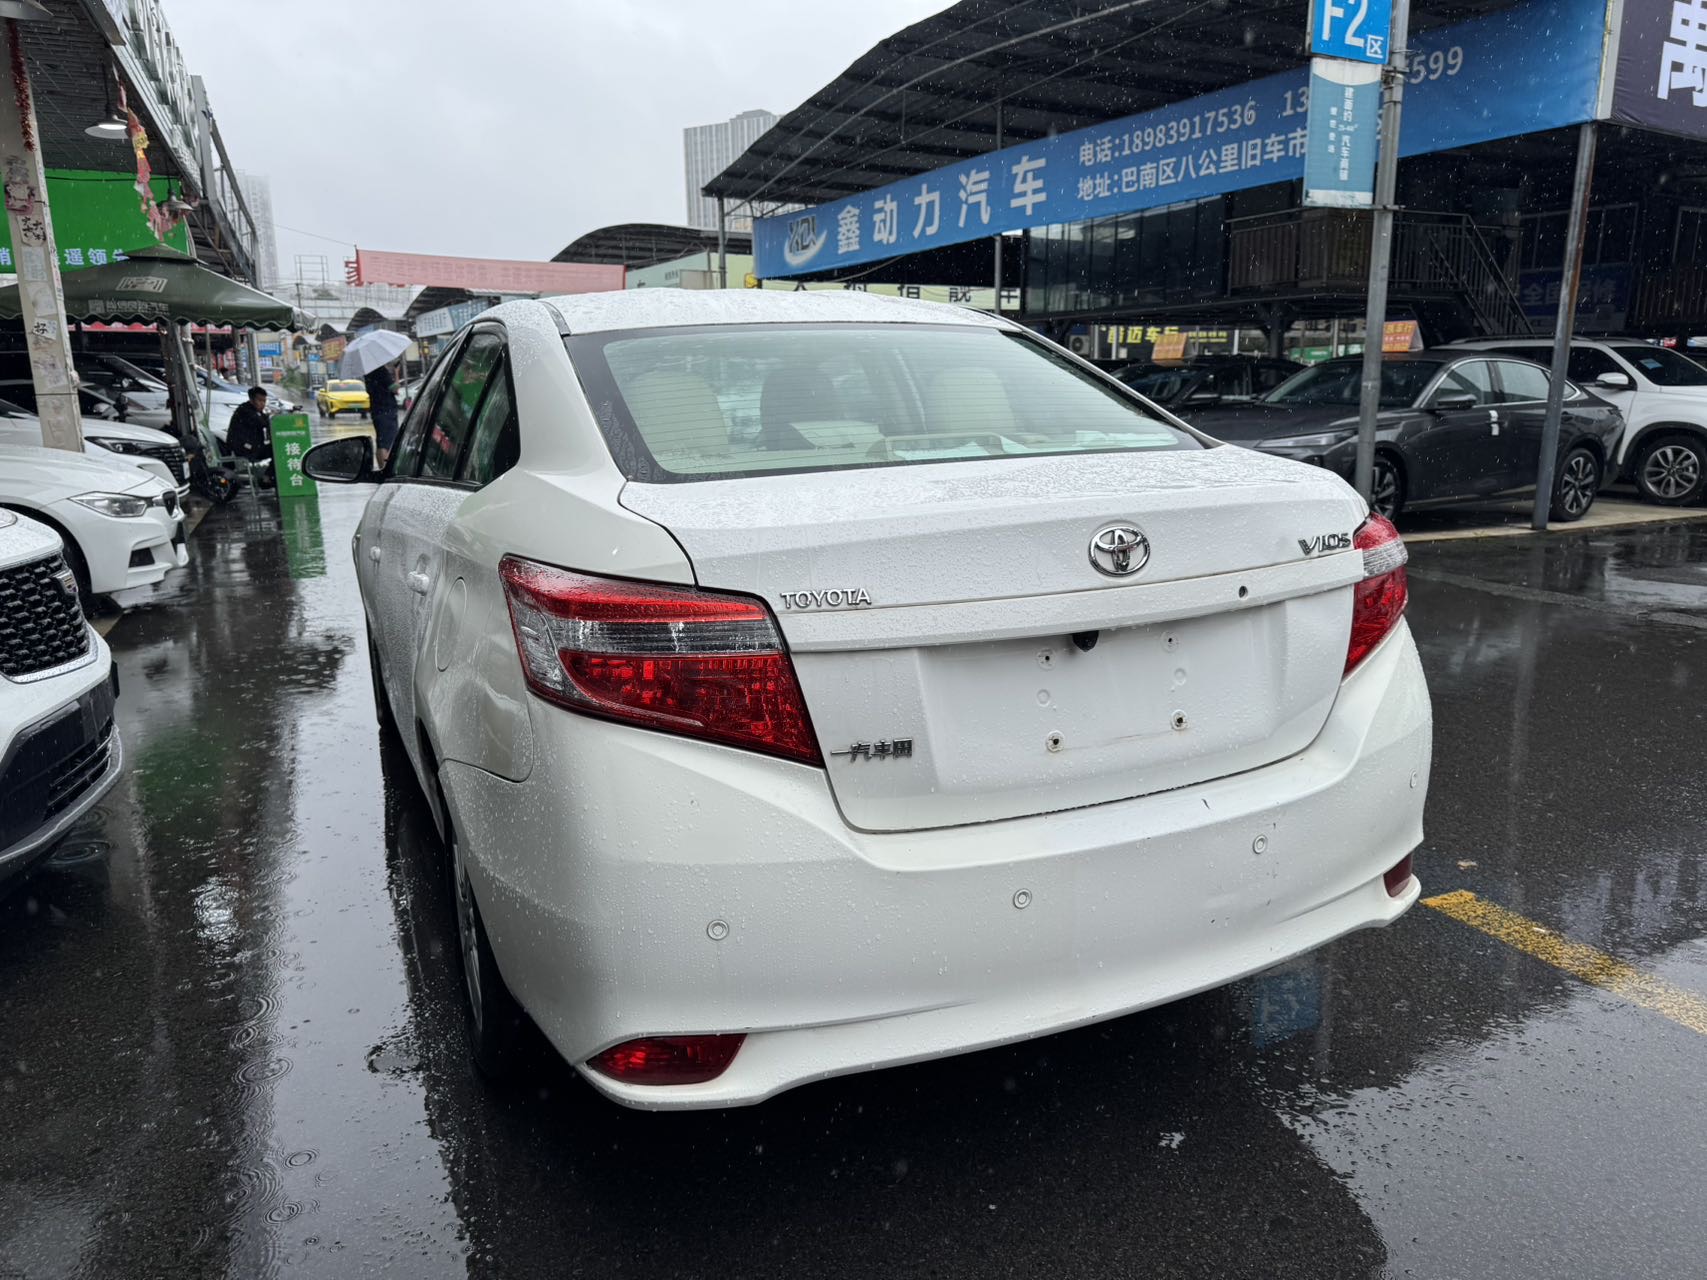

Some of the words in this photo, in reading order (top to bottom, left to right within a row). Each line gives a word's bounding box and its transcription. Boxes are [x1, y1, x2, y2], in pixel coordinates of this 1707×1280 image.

[837, 155, 1048, 255] 鑫动力汽车
[285, 442, 303, 486] 接待台
[1297, 532, 1352, 556] VIOS
[780, 587, 872, 609] TOYOTA
